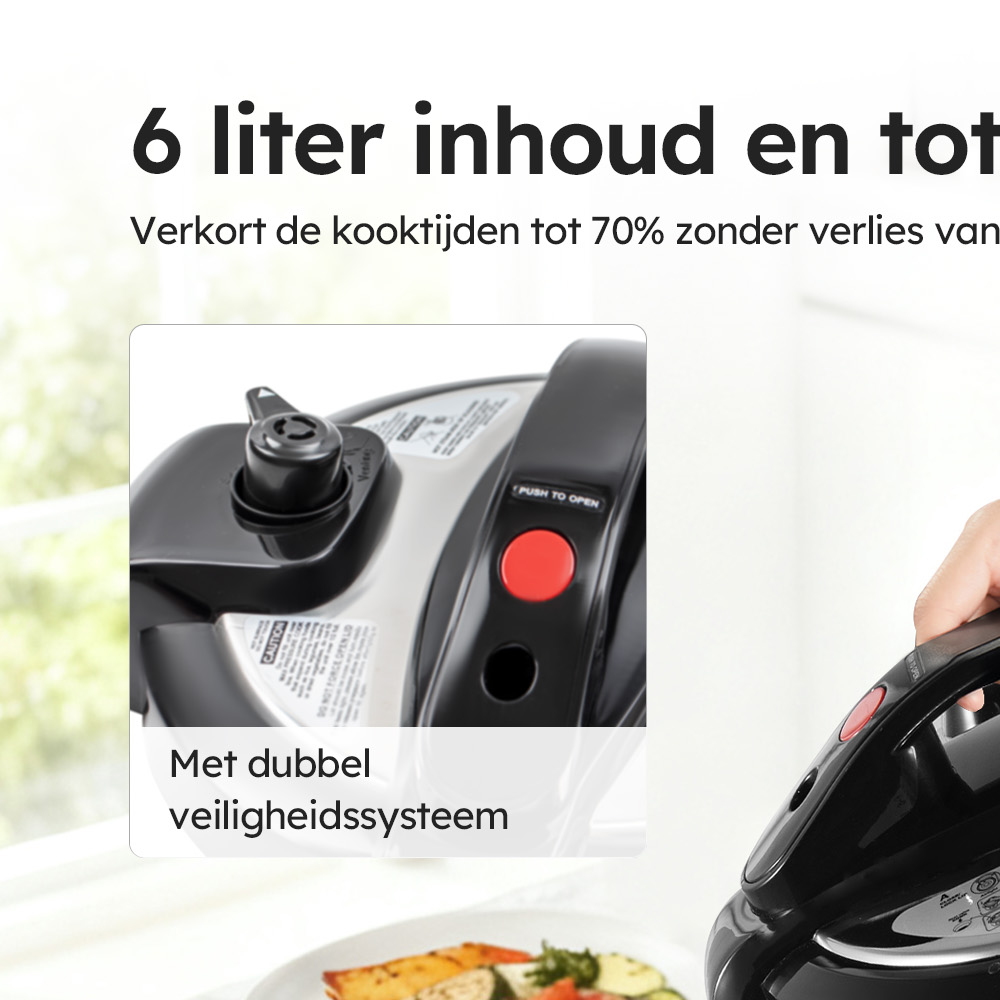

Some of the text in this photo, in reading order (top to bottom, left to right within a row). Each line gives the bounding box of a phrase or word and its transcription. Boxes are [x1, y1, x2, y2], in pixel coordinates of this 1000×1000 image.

[518, 486, 600, 509] PUSH TO OPEN
[263, 621, 286, 663] CAUTION
